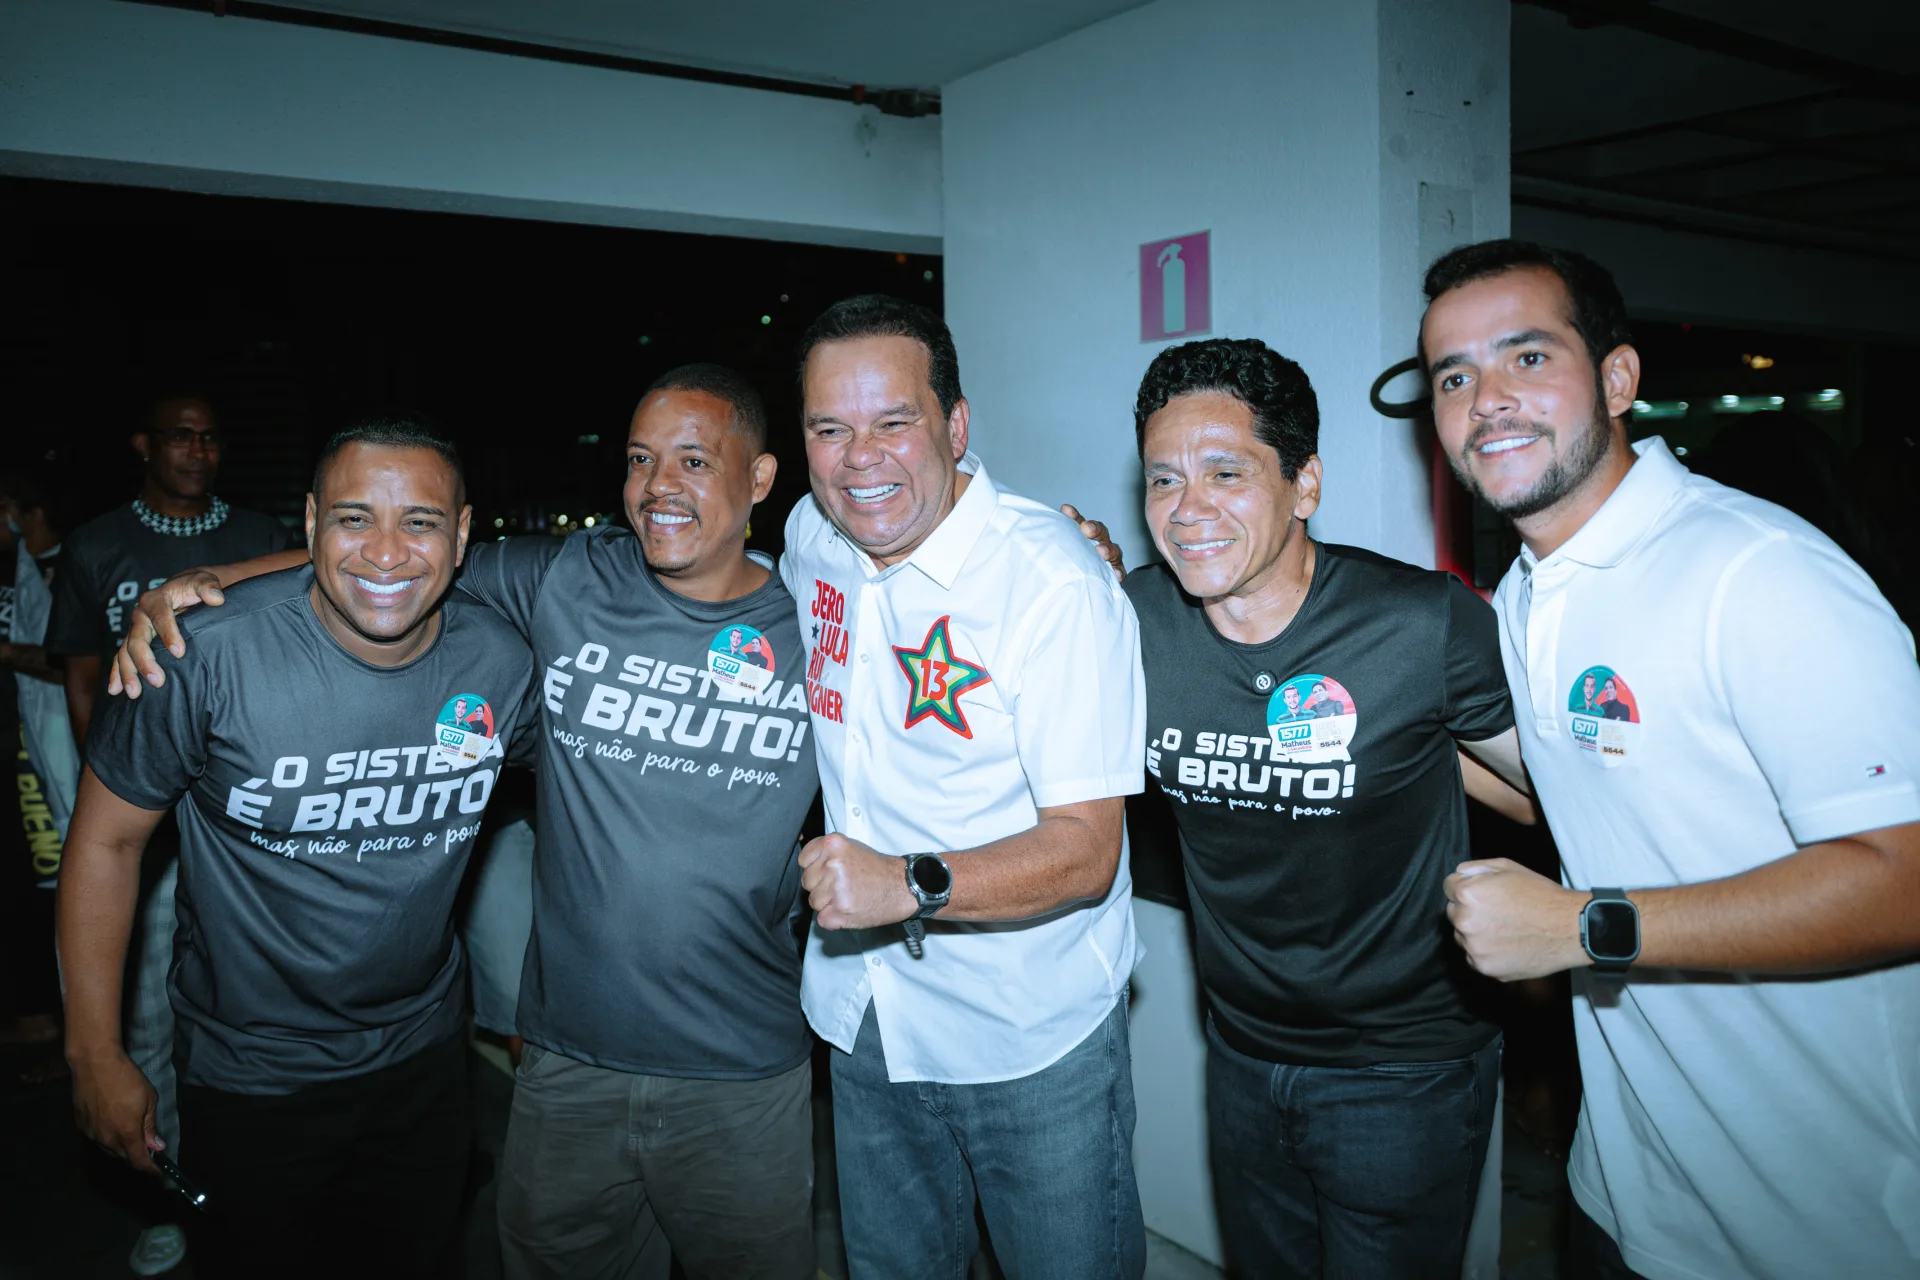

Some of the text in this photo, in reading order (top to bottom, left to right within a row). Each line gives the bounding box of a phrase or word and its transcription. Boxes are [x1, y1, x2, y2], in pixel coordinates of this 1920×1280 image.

[117, 580, 140, 602] O
[812, 579, 845, 625] JERO
[807, 646, 826, 682] RUI
[820, 622, 849, 667] LULA
[575, 642, 808, 713] O SISTMA
[920, 659, 950, 701] 13
[543, 656, 809, 763] É BRUTO!
[271, 733, 504, 789] O SISTEA
[553, 724, 781, 790] mas não para o povo.
[1162, 728, 1352, 763] O SIST
[1281, 740, 1312, 748] Matheus
[1320, 740, 1342, 748] 5544
[1603, 746, 1624, 755] 5544
[1146, 739, 1356, 800] É BRUTO!
[226, 778, 273, 829] É
[1161, 784, 1188, 804] mas
[1228, 798, 1267, 811] para
[1274, 803, 1285, 812] o
[250, 831, 300, 860] mas
[307, 833, 351, 855] não
[357, 833, 416, 863] para
[422, 833, 437, 847] o
